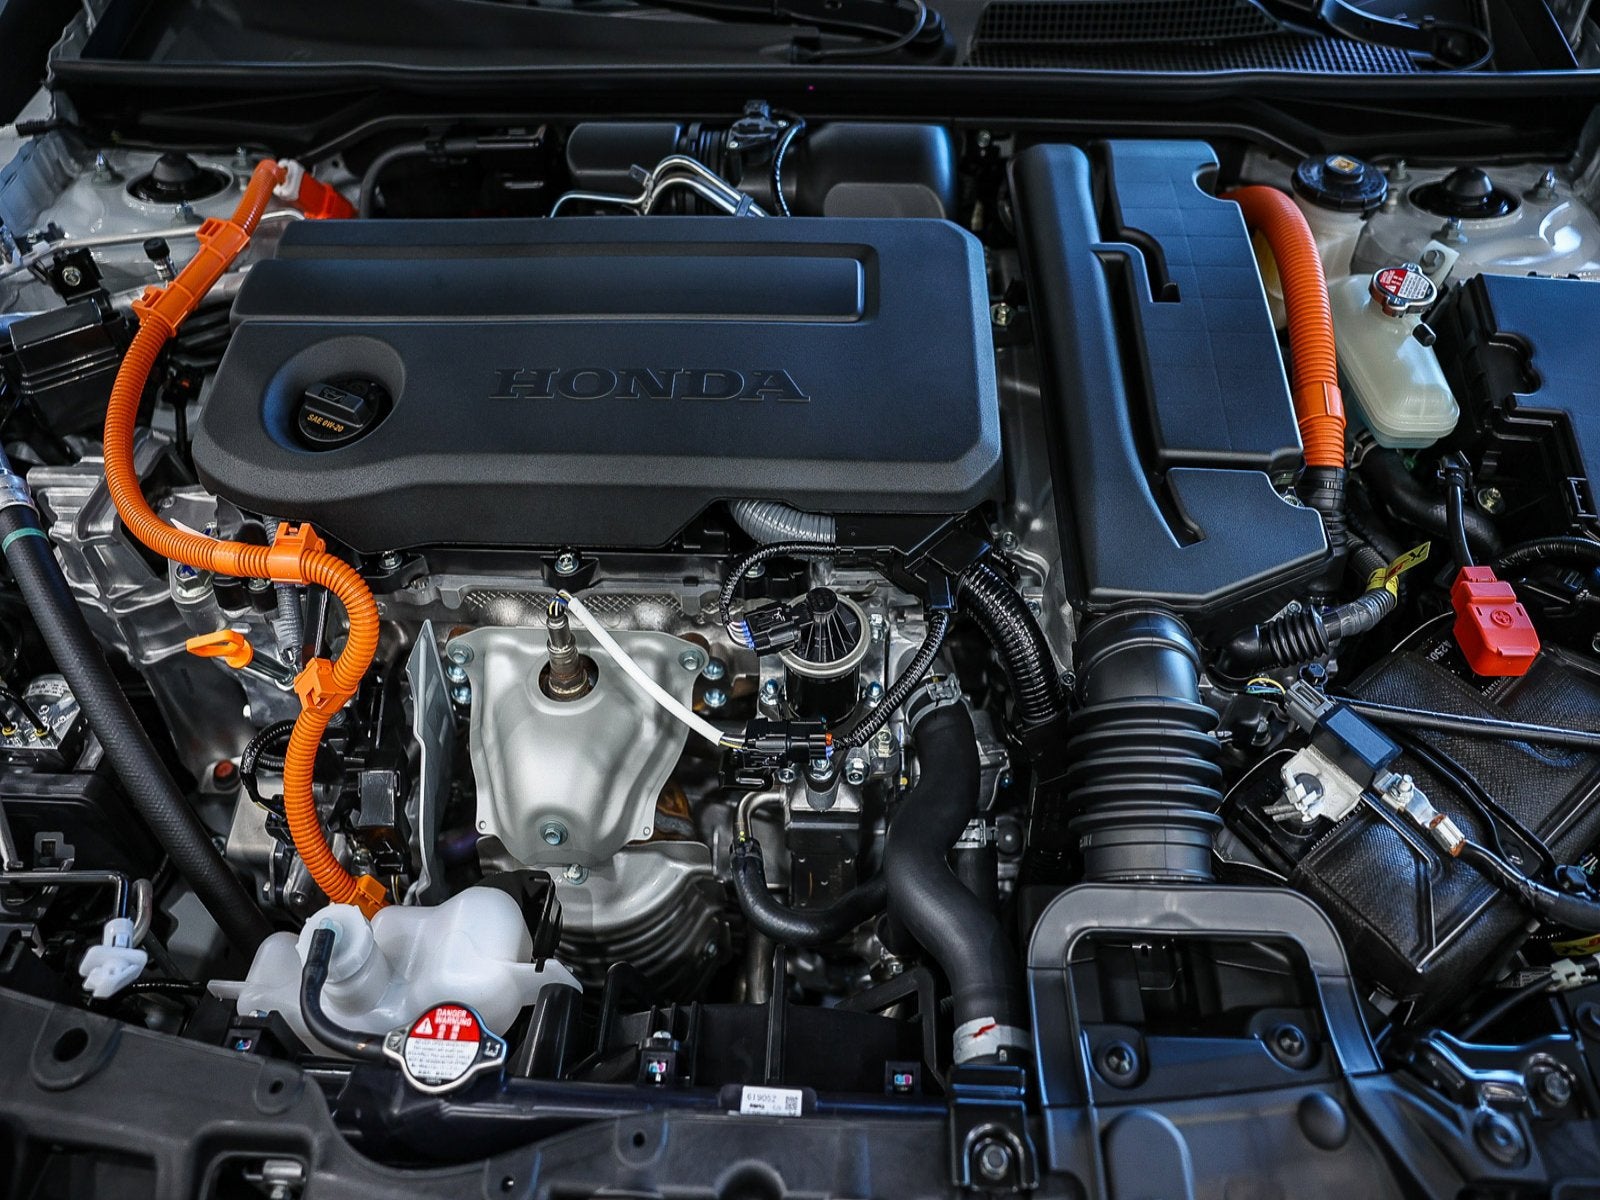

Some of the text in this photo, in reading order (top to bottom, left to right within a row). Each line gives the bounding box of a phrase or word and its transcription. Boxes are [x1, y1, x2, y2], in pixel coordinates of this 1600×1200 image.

[488, 367, 811, 402] HONDA
[307, 414, 344, 432] SAE 0W-20
[435, 1015, 472, 1027] WARNUNG
[436, 1008, 467, 1019] DANGER
